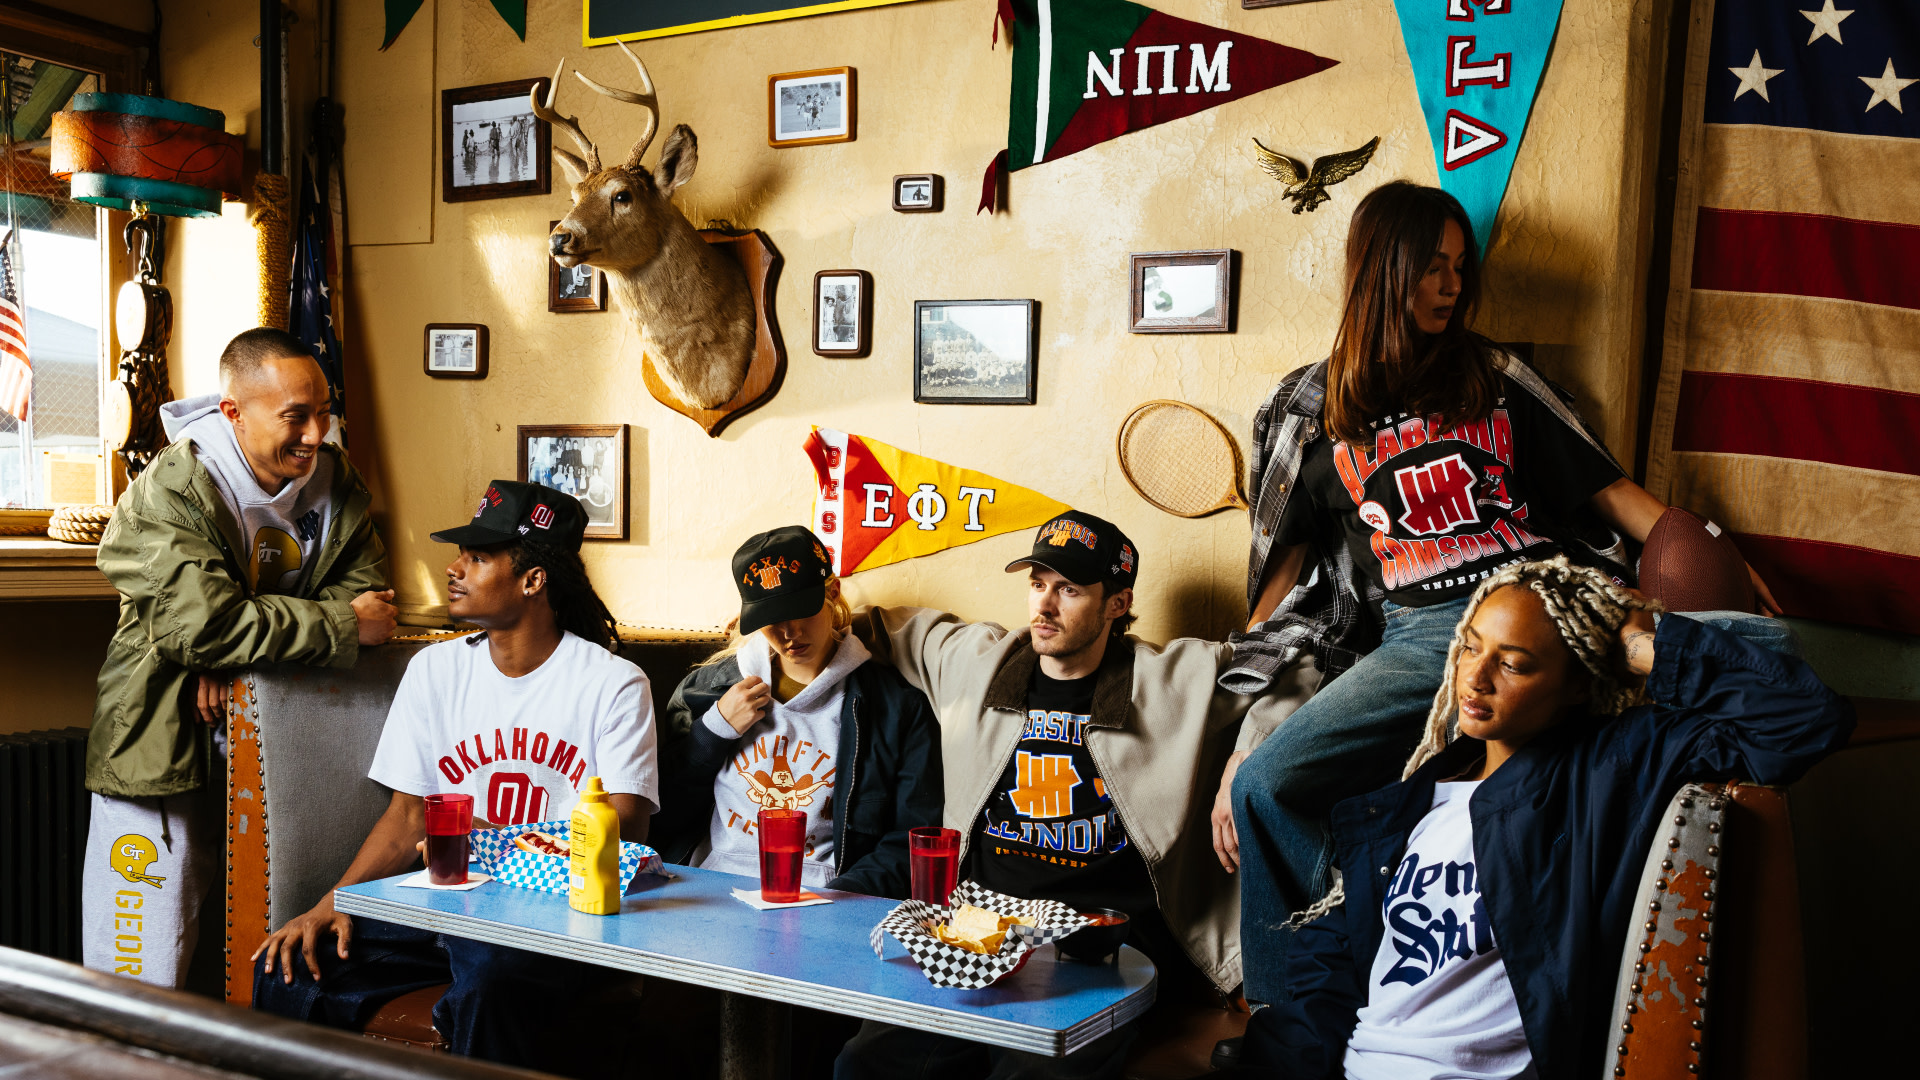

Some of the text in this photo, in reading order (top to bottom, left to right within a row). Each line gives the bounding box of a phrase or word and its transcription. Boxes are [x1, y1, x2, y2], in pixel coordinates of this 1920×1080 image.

[1036, 519, 1098, 550] ILLINOIS
[743, 556, 801, 587] TEXAS
[1370, 530, 1504, 590] CRIMSON
[438, 727, 587, 791] OKLAHOMA
[120, 843, 145, 860] GT
